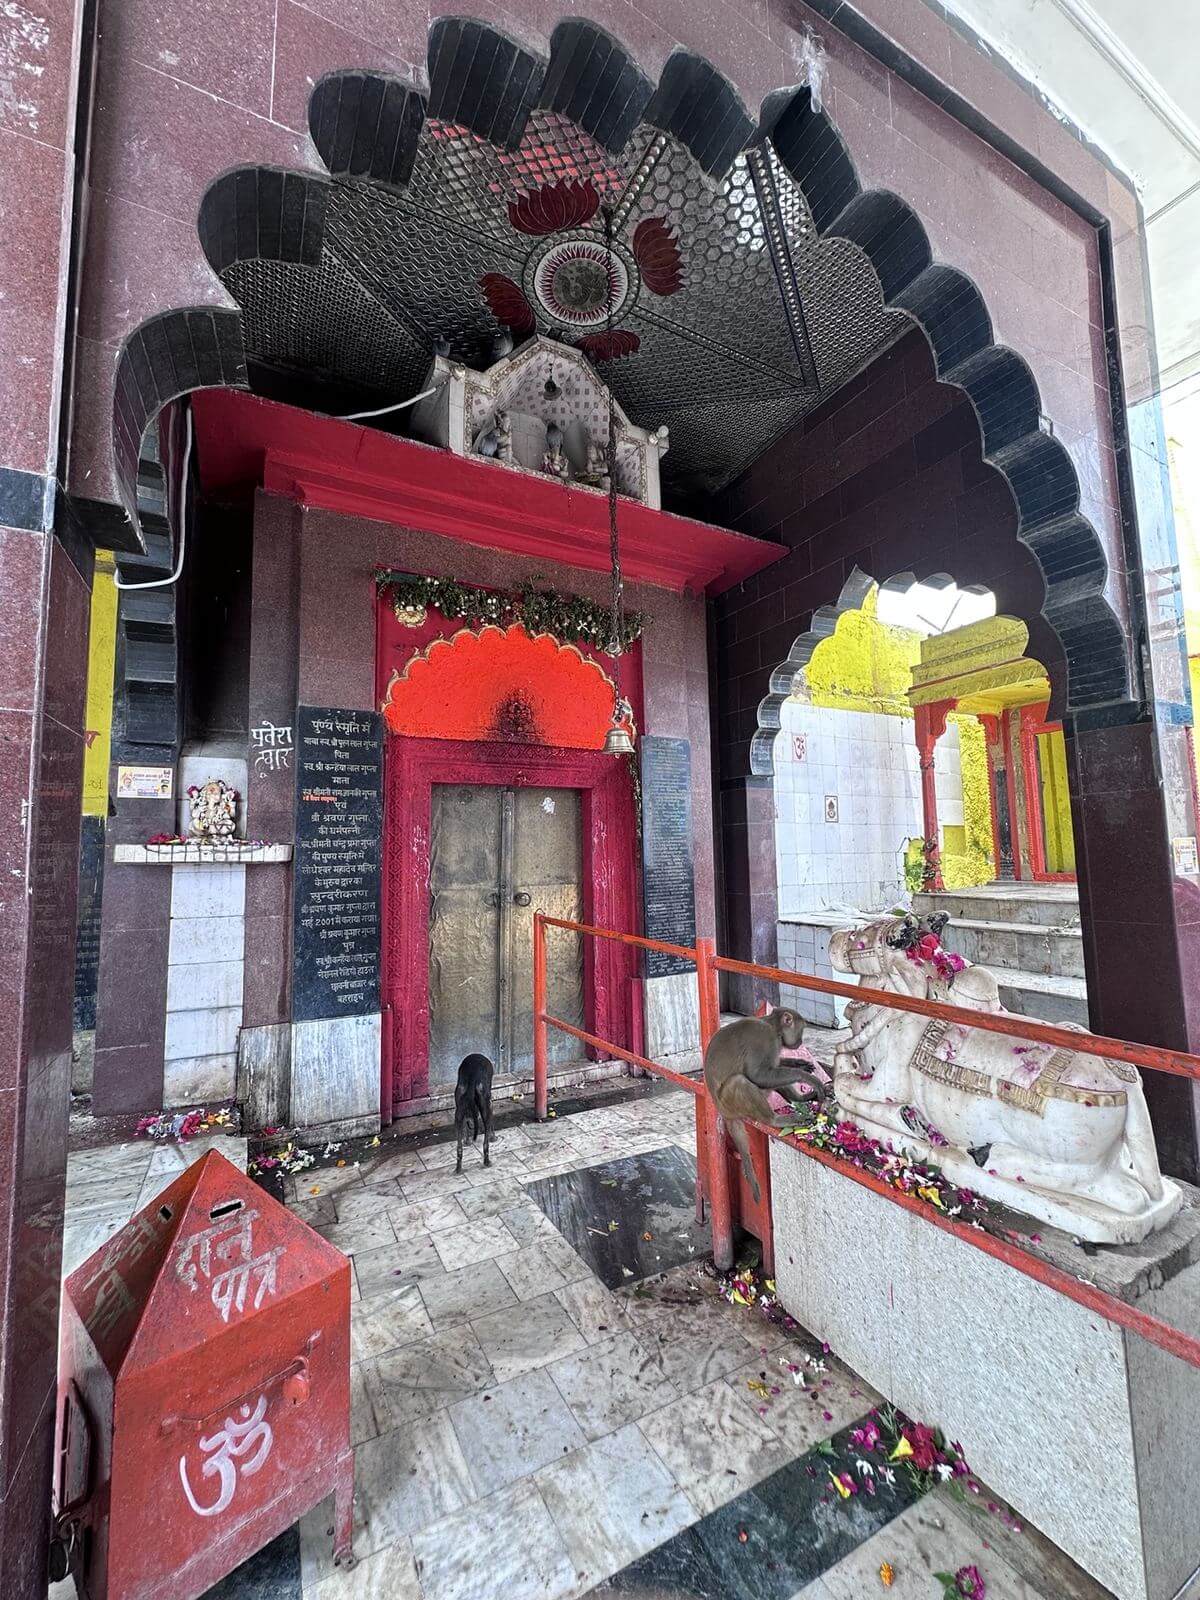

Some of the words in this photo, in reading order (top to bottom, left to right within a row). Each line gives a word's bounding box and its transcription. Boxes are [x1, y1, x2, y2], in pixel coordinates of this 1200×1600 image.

[311, 719, 333, 733] पुण्य
[335, 720, 360, 735] स्मृति
[361, 722, 371, 734] में
[363, 739, 378, 750] गुप्ता
[334, 749, 349, 759] पिता
[315, 761, 324, 771] श्री
[346, 764, 360, 772] लाल
[361, 765, 378, 775] गुप्ता
[332, 776, 350, 785] माता
[361, 790, 377, 799] गुप्ता
[334, 800, 347, 810] एवं
[311, 812, 320, 822] श्री
[323, 814, 345, 822] श्रवण
[348, 814, 368, 825] गुप्ता
[318, 825, 328, 835] की
[330, 825, 361, 835] धर्मपत्नी
[311, 839, 332, 848] श्रीमती
[361, 839, 377, 850] गुप्ता
[312, 851, 321, 861] की
[321, 853, 337, 863] पुण्य
[338, 851, 357, 862] स्मृति
[333, 863, 356, 874] महादेव
[314, 878, 323, 887] के
[323, 878, 340, 888] मुख्य
[353, 877, 363, 885] का
[310, 888, 368, 903] सुन्दरीकरण
[327, 904, 345, 914] कुमार
[346, 903, 362, 913] गुप्ता
[315, 918, 335, 926] 2001
[344, 928, 361, 940] कुमार
[176, 1209, 260, 1291] दान
[211, 1245, 287, 1323] पात्र
